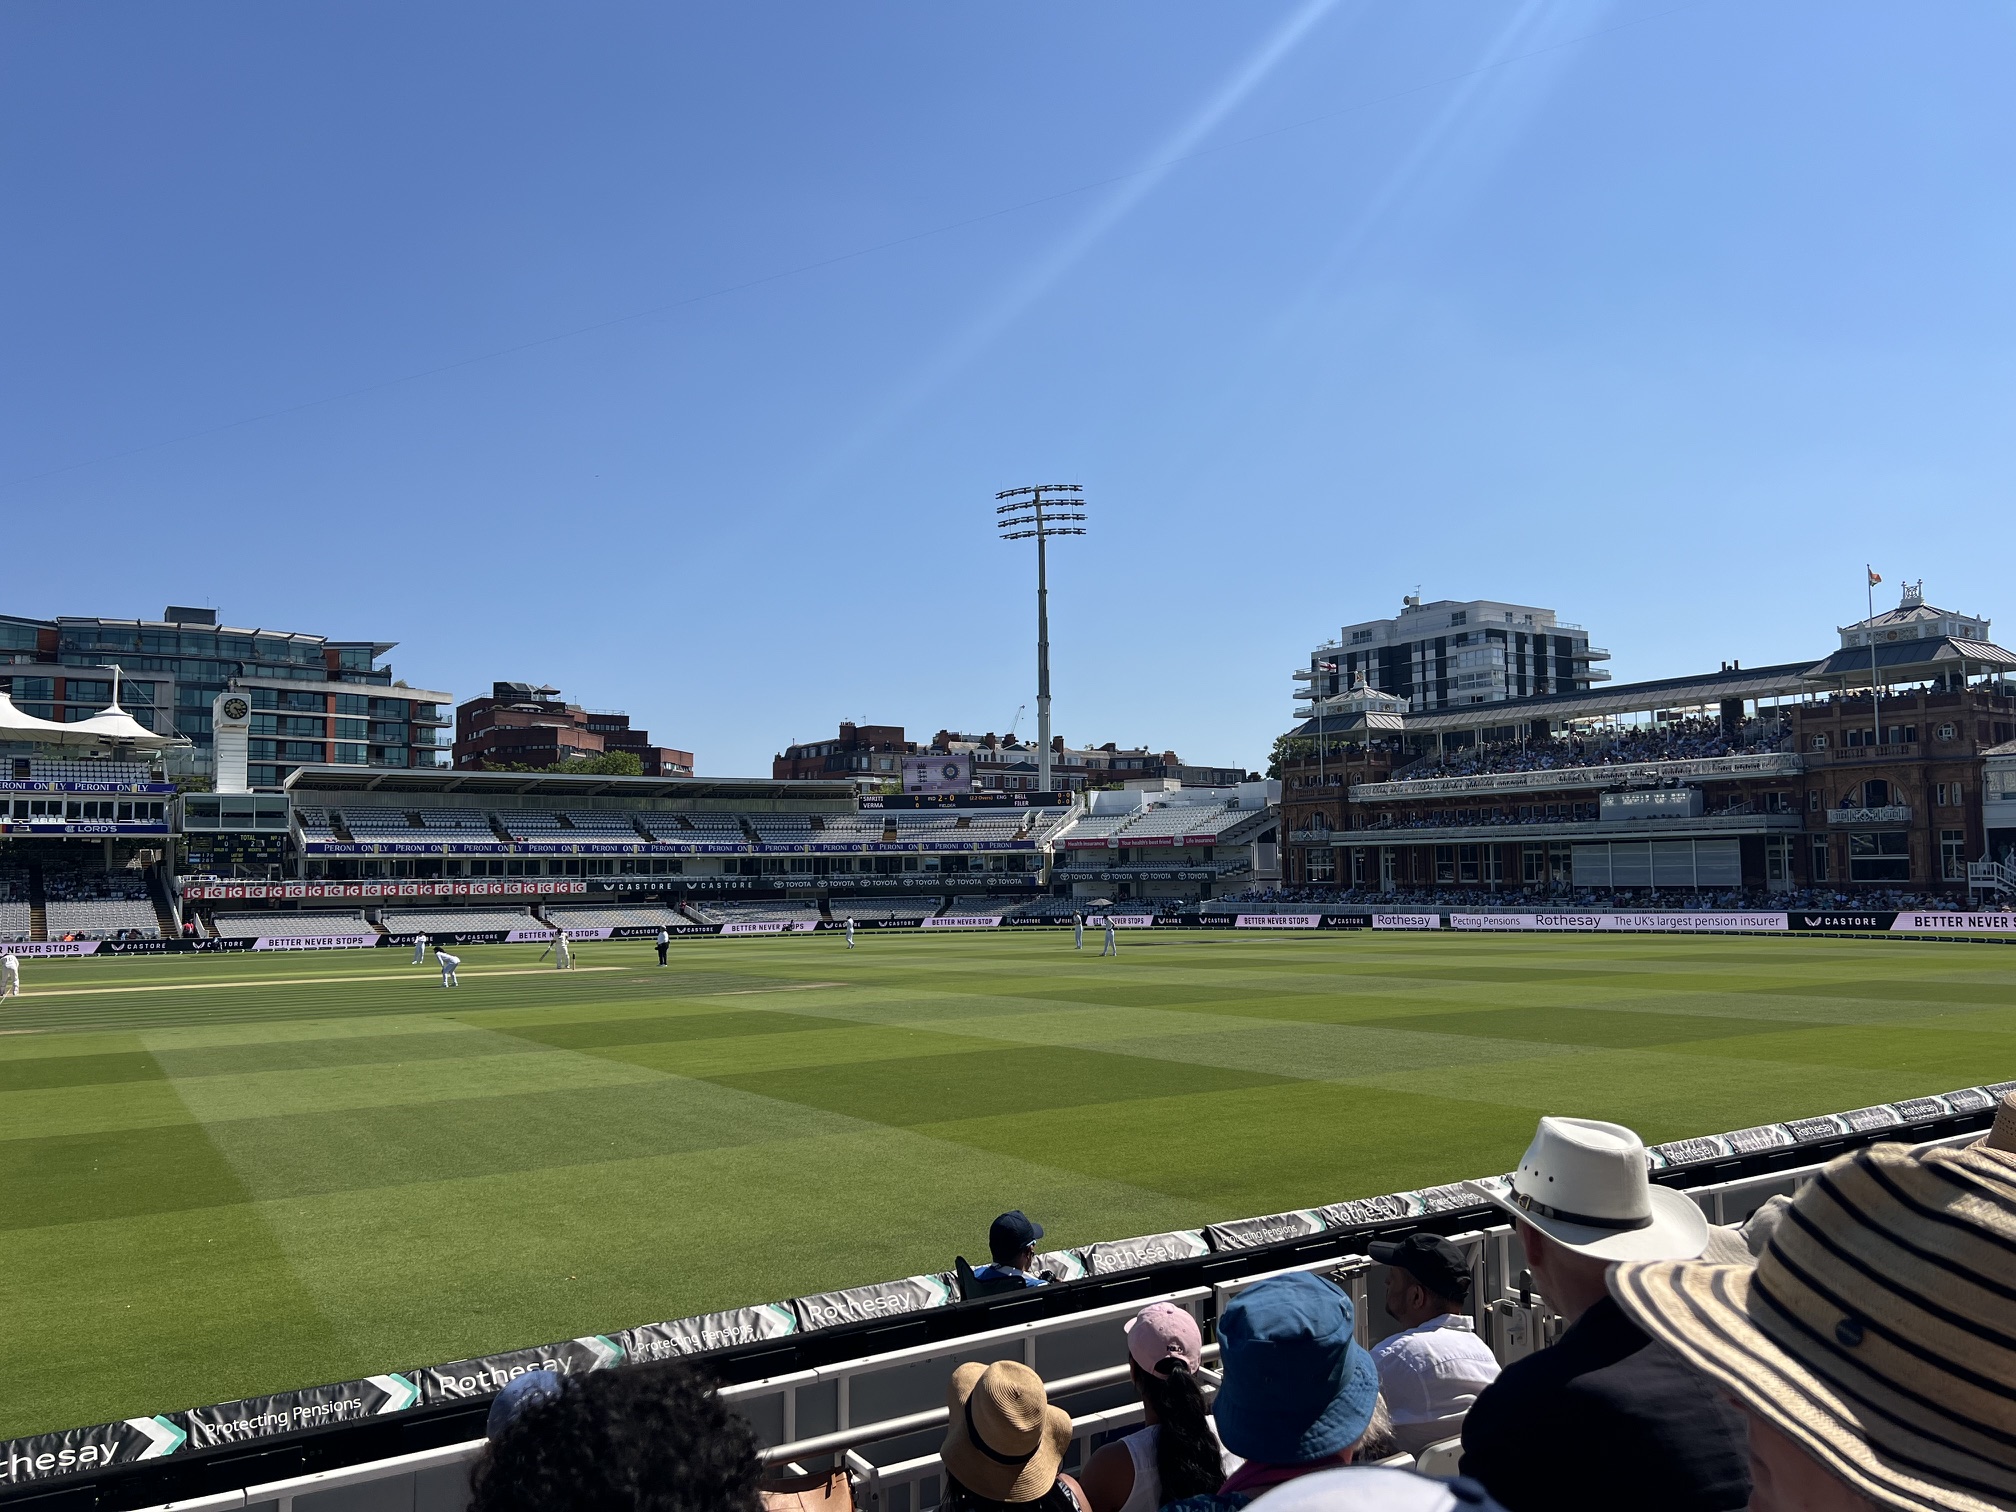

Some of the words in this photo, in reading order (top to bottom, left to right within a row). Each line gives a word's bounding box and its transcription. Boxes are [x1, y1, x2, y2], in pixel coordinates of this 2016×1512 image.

[75, 783, 110, 791] PERONI
[957, 918, 976, 926] NEVER
[1128, 916, 1144, 924] STOPS
[1244, 917, 1266, 925] BETTER
[1267, 917, 1287, 925] NEVER
[1288, 916, 1309, 925] STOPS
[1377, 914, 1431, 928] Rothesay
[1483, 916, 1520, 926] Pensions
[1536, 914, 1601, 928] Rothesay
[1614, 916, 1632, 926] The
[1634, 916, 1655, 926] UK's
[1657, 916, 1692, 928] largest
[1694, 916, 1737, 929] pension
[1739, 916, 1780, 926] insurer
[1824, 917, 1877, 926] CASTORE
[1915, 916, 1963, 927] BETTER
[1968, 916, 2009, 927] NEVER
[518, 931, 547, 939] BETTER
[269, 938, 302, 947] BETTER
[305, 937, 333, 946] NEVER
[336, 937, 363, 945] STOPS
[7, 945, 41, 954] NEVER
[45, 944, 79, 953] STOPS
[1900, 1103, 1938, 1116] Rothesay
[1794, 1123, 1835, 1137] Rothesay
[1667, 1145, 1714, 1162] Rothesay
[1331, 1199, 1398, 1222] Rothesay
[1221, 1229, 1263, 1245] Protecting
[1263, 1223, 1298, 1239] Pensions
[1092, 1243, 1176, 1270] Rothesay
[808, 1292, 911, 1323] Rothesay
[637, 1333, 699, 1355] Protecting
[701, 1322, 754, 1343] Pensions
[438, 1355, 573, 1396] Rothesay
[206, 1410, 288, 1436] Protecting
[293, 1395, 362, 1421] Pensions
